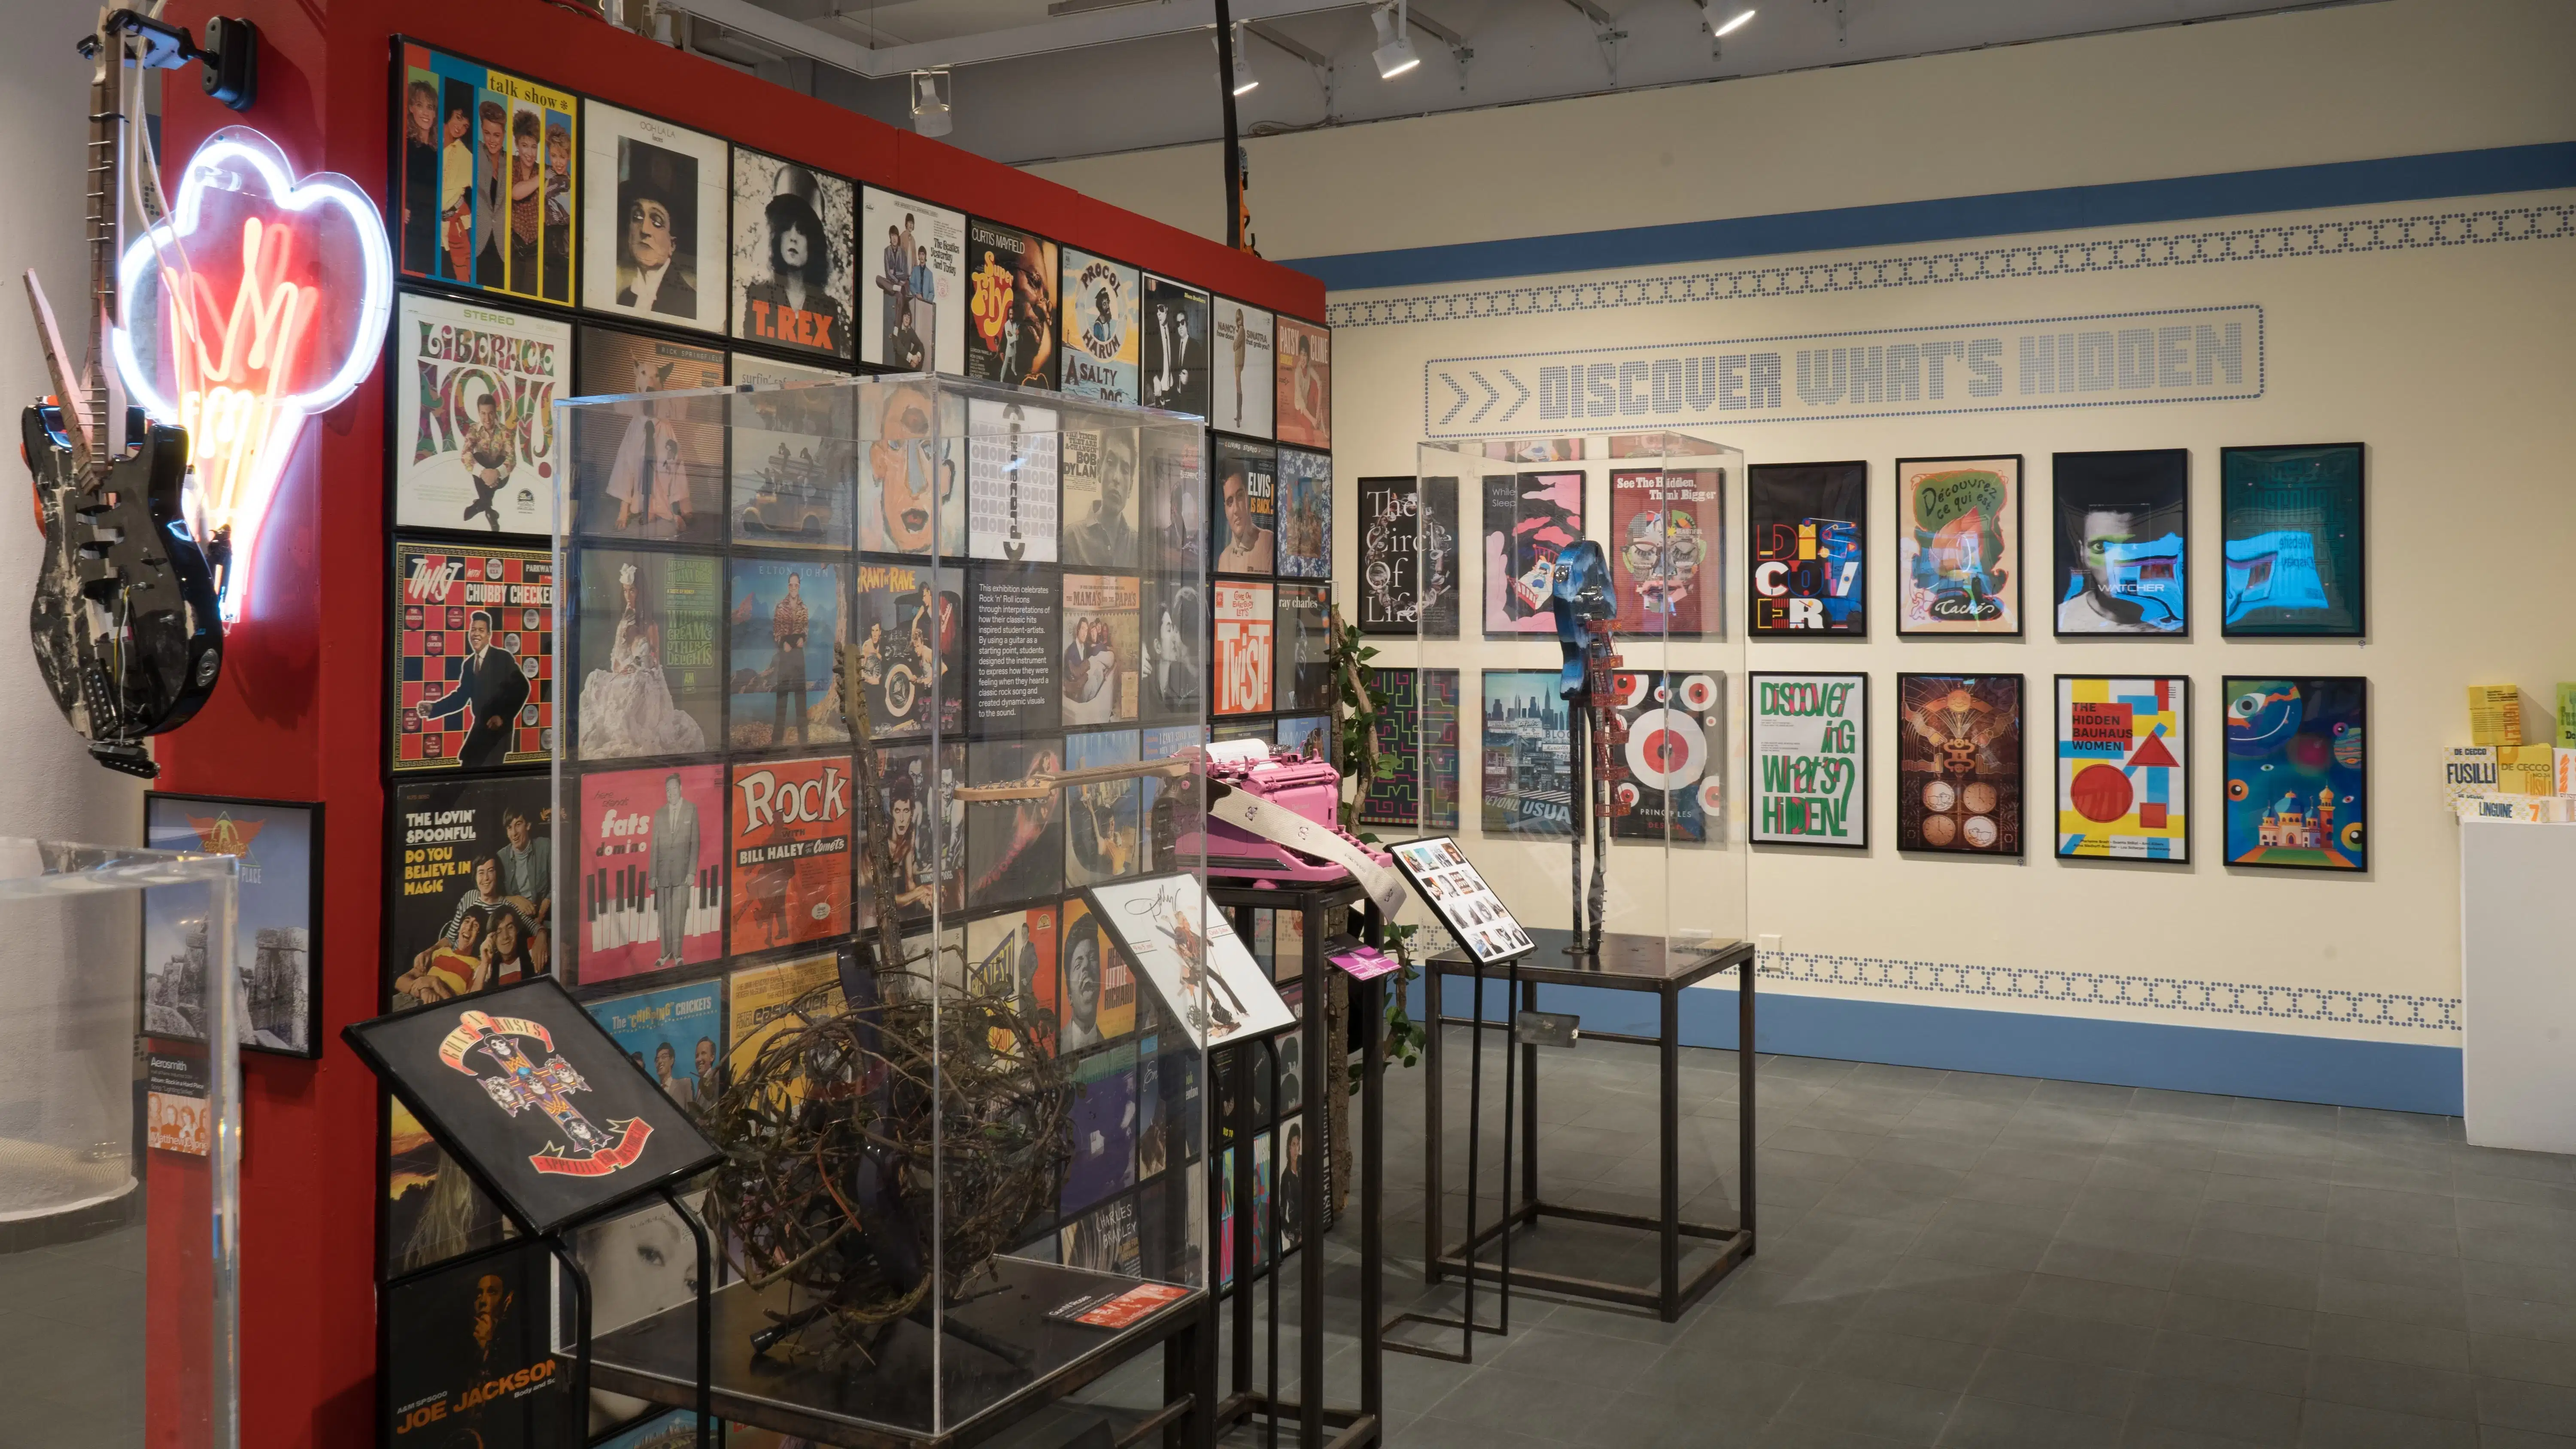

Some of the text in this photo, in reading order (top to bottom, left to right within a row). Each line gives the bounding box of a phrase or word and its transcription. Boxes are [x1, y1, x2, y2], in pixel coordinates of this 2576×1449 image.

[490, 76, 557, 109] talk show
[943, 240, 960, 254] Beatles
[972, 227, 994, 245] CURTIS
[996, 235, 1025, 254] MAYFIELD
[930, 247, 953, 264] Yesterday
[933, 258, 957, 276] And Today
[984, 251, 1014, 285] Super
[1081, 263, 1121, 298] PROCOL
[971, 271, 1014, 337] Fly
[464, 309, 515, 326] STEREO
[753, 299, 833, 350] T.REX
[1218, 321, 1267, 343] NANCY SINATRA
[1224, 332, 1234, 340] does
[1082, 328, 1121, 359] HARUM
[1280, 325, 1328, 364] PATSY CLINE
[661, 346, 723, 363] RICK SPRINGFIELD
[1065, 355, 1118, 386] A SALTY
[1539, 322, 2243, 420] DISCOVER WHAT'S HIDDEN
[1100, 388, 1122, 403] DOG
[1227, 442, 1258, 453] LIVING STEREO
[1076, 451, 1097, 465] BOB
[1063, 462, 1097, 478] DYLAN
[1248, 472, 1271, 498] ELVIS
[1492, 485, 1516, 496] While
[1617, 477, 1655, 489] See The
[1367, 487, 1417, 519] The
[1492, 499, 1517, 509] Sleep
[1680, 489, 1716, 501] Bigger
[1923, 476, 1998, 516] Découvrez
[1251, 497, 1256, 513] IS
[1937, 491, 1992, 519] ce qui est
[1367, 521, 1452, 552] Circle
[408, 558, 464, 601] TWIST
[759, 566, 829, 580] ELTON JOHN
[858, 566, 915, 594] RANT RAVE
[1366, 558, 1404, 588] Of
[466, 583, 507, 603] CHUBBY
[979, 584, 991, 592] This
[993, 585, 1020, 593] exhibition
[2098, 584, 2165, 592] WATCHER
[1073, 591, 1136, 606] MAMA'S PAPA'S
[1279, 596, 1318, 610] ray charles
[979, 605, 1002, 614] through
[1002, 606, 1043, 615] interpretations
[1367, 595, 1420, 624] Life
[667, 621, 704, 640] CREAM
[979, 626, 1001, 634] inspired
[979, 637, 986, 645] By
[1009, 637, 1025, 645] guitar
[667, 647, 713, 665] DELIGHTS
[979, 647, 1001, 656] starting
[979, 658, 1004, 666] designed
[1022, 667, 1034, 676] they
[2072, 703, 2096, 712] THE
[2072, 715, 2120, 725] HIDDEN
[2072, 728, 2133, 739] BAUHAUS
[2072, 741, 2122, 751] WOMEN
[2446, 763, 2496, 784] FUSILLI
[2516, 764, 2551, 772] CECCO
[734, 765, 850, 837] ROCK
[1485, 795, 1519, 812] BEYOND
[406, 809, 476, 827] THE LOVIN'
[2479, 801, 2540, 822] LINGUINE 7
[601, 809, 650, 838] fats
[406, 825, 476, 843] SPOONFUL
[781, 828, 805, 838] WITH
[405, 846, 453, 864] DO YOU
[595, 839, 647, 857] domino
[739, 838, 845, 865] BILL HALEY Comets
[241, 867, 261, 884] PLACE
[404, 860, 471, 880] BELIEVE IN
[404, 879, 443, 896] MAGIC
[1106, 964, 1128, 990] LITTLE
[1104, 982, 1134, 1011] RICHARD
[612, 1016, 626, 1030] The
[675, 996, 712, 1016] CRICKETS
[492, 1018, 541, 1037] ROSES
[151, 1056, 187, 1071] Aerosmith
[153, 1132, 185, 1145] Matthew
[1095, 1203, 1132, 1233] CHARLES
[1103, 1221, 1136, 1249] BRADLEY
[514, 1382, 546, 1398] Body and
[396, 1400, 447, 1434] JOE
